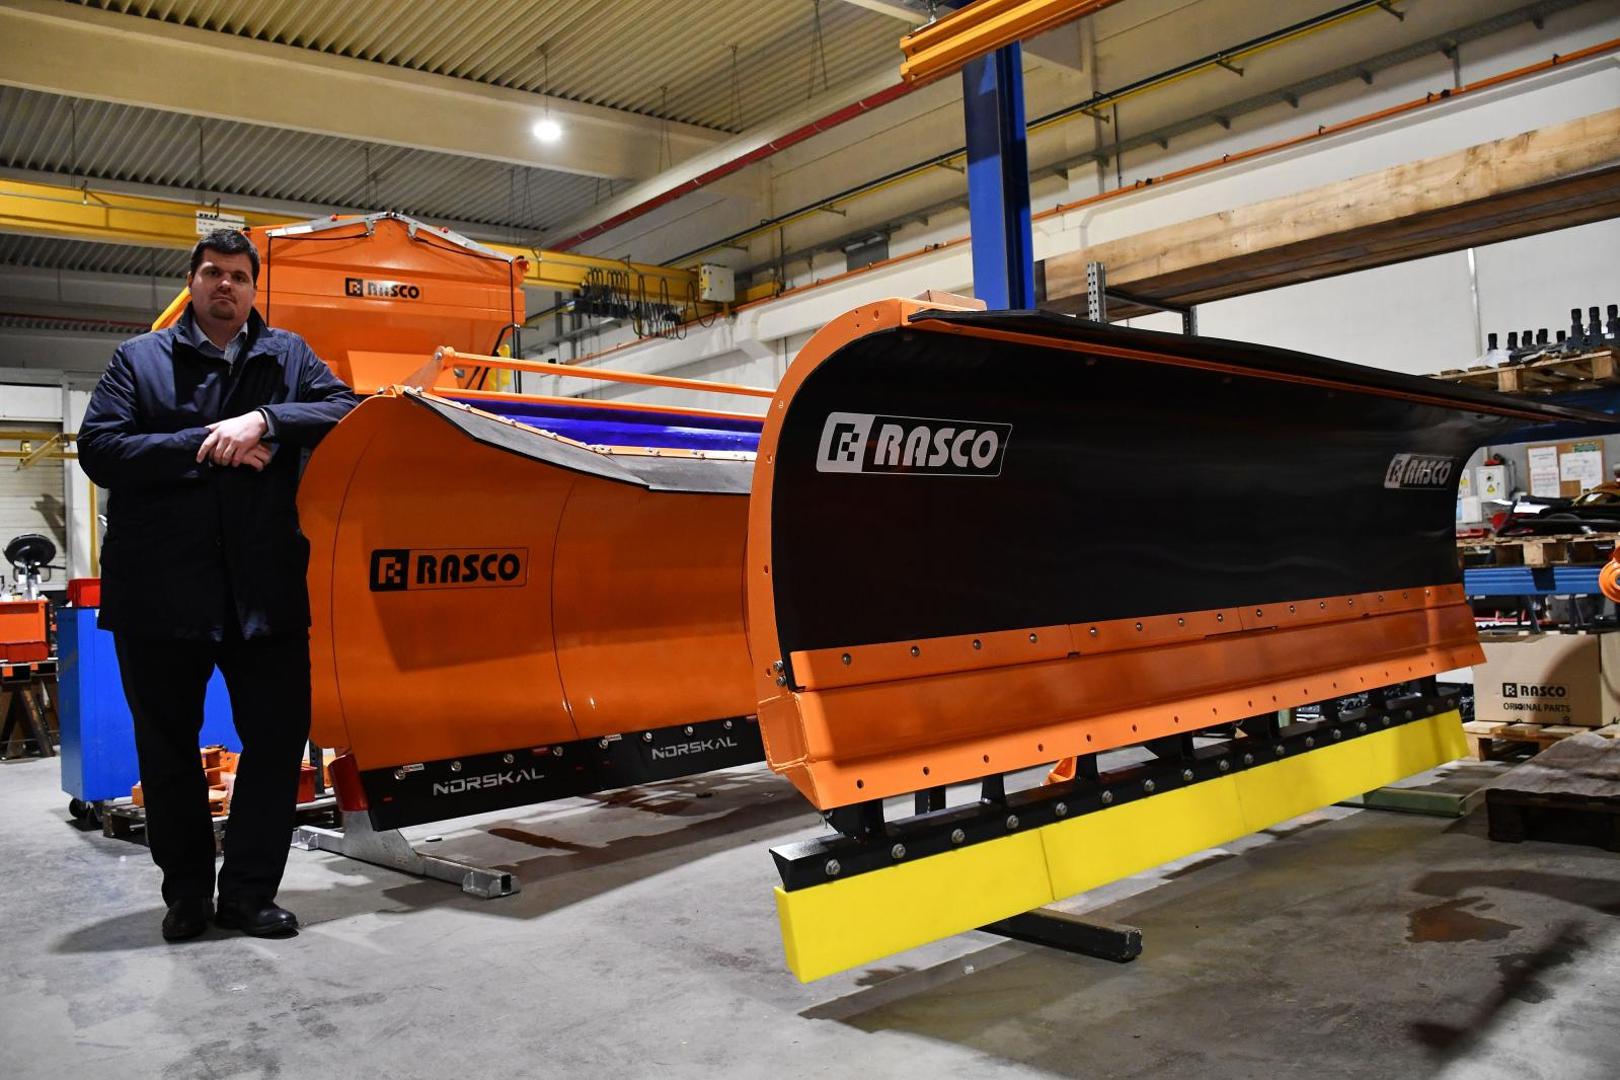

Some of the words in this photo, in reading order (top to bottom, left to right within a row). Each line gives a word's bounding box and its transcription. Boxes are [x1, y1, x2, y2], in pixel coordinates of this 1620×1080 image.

[873, 423, 999, 469] RASCO
[1403, 459, 1452, 485] RASCO
[416, 553, 520, 584] RASCO
[1520, 685, 1566, 698] RASCO
[1543, 704, 1571, 713] PARTS
[651, 736, 738, 760] NORSKAL
[432, 768, 545, 796] NORSKAL
